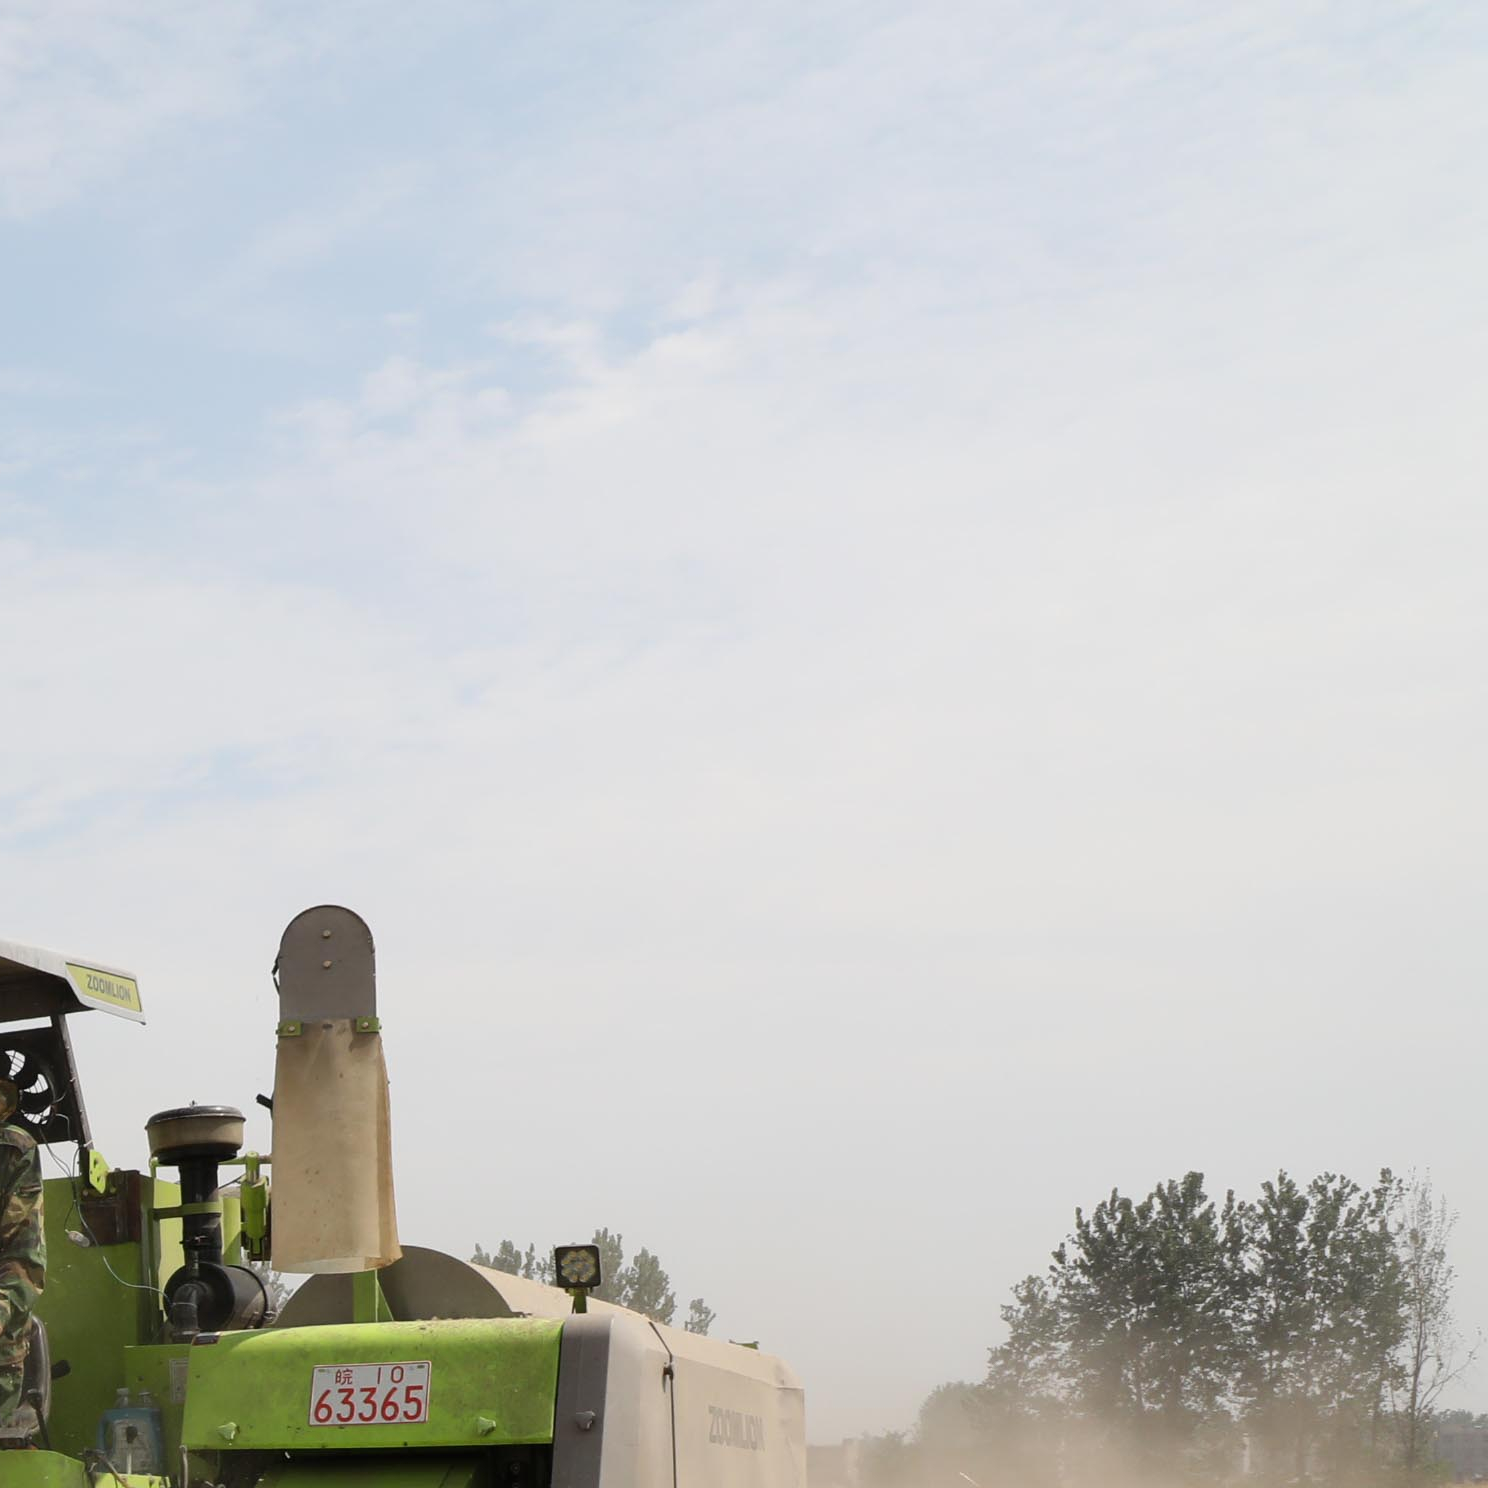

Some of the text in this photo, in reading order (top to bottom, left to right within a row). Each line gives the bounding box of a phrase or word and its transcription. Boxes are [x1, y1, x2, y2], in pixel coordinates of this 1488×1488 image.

[86, 973, 131, 1002] ZOOMLION
[335, 1368, 353, 1386] 皖
[314, 1385, 424, 1423] 63365
[707, 1404, 765, 1452] ZOOMLION
